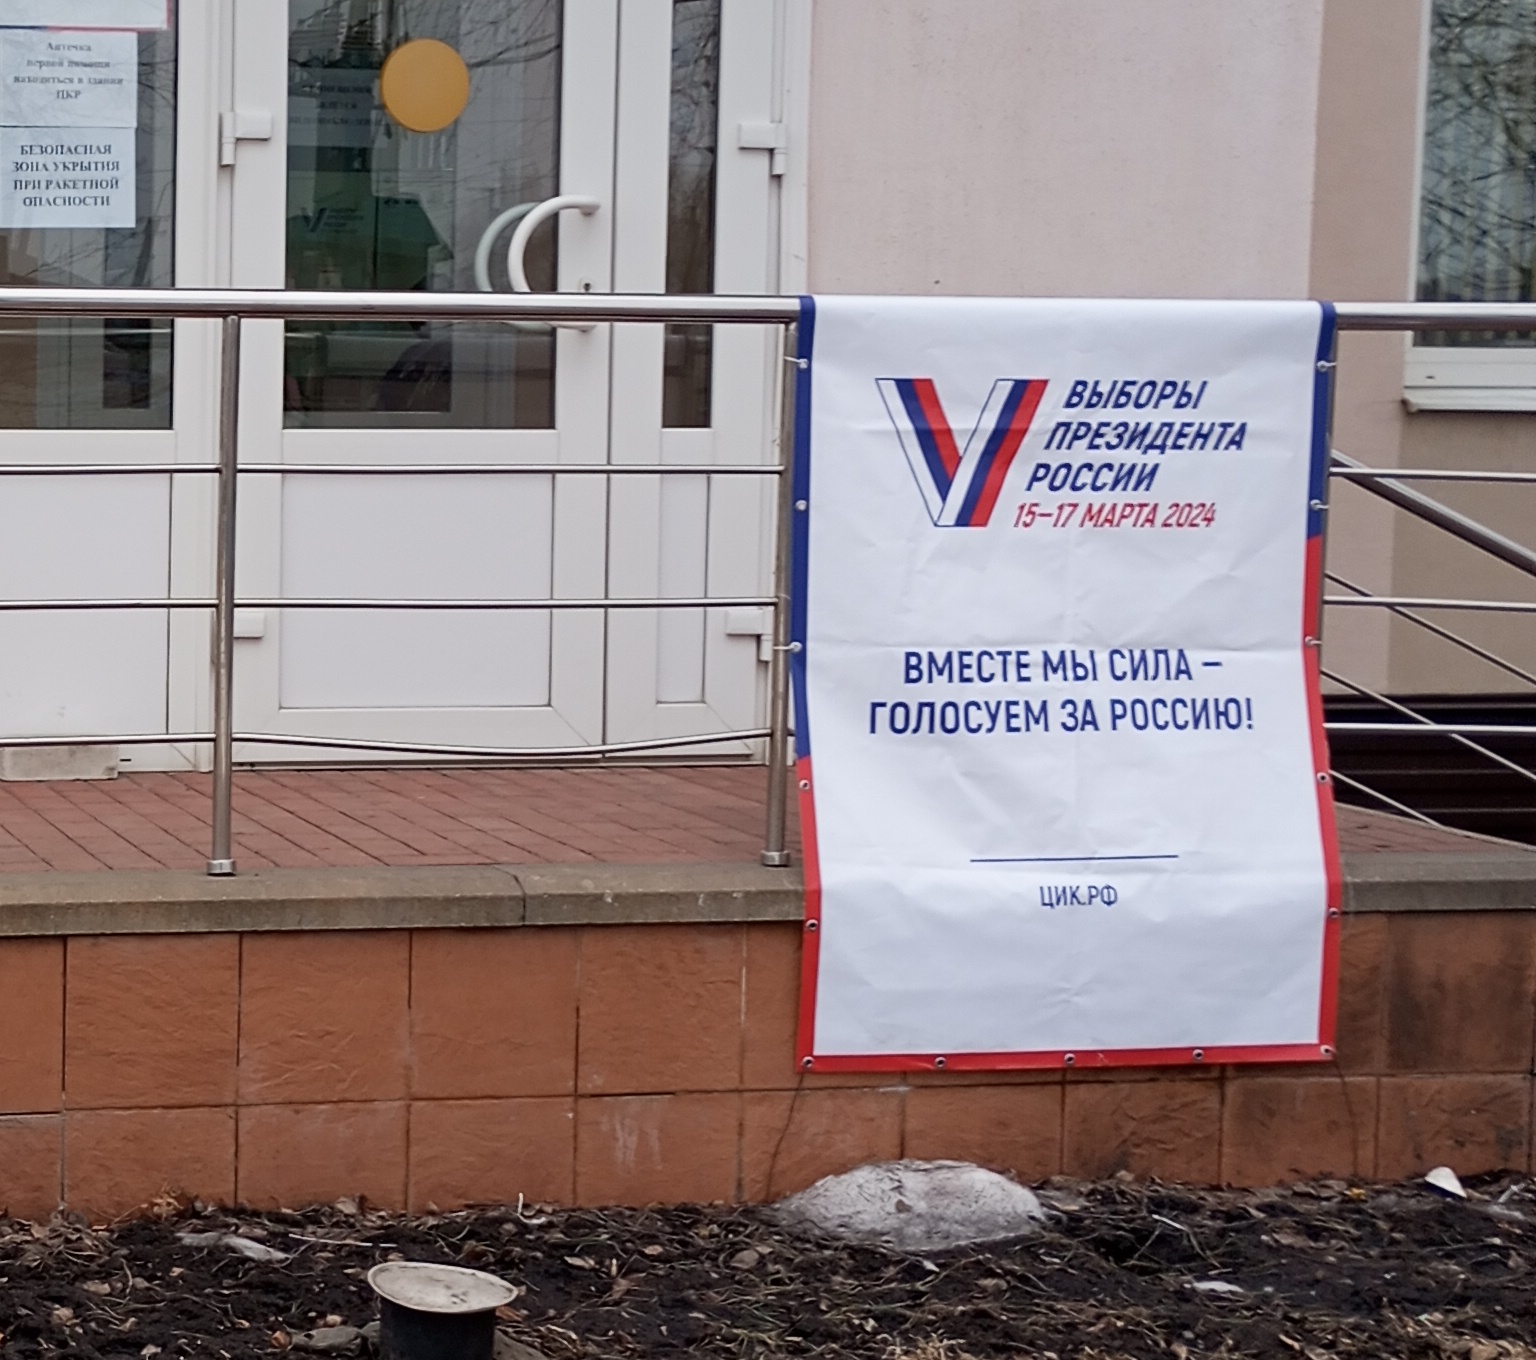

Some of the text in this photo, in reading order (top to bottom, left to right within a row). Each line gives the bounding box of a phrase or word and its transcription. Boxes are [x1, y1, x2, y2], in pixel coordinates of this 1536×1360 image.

[20, 145, 112, 156] БЕЗОПАСНАЯ
[13, 161, 120, 172] ЗОНА УКРЫТИЯ
[14, 178, 119, 190] ПРИ РАКЕТНОЙ
[23, 196, 110, 207] ОПАСНОСТИ
[1063, 380, 1207, 409] ВЫБОРЫ
[1044, 422, 1248, 454] ПРЕЗИДЕНТА
[1026, 463, 1160, 492] РОССИИ
[1080, 503, 1158, 528] МАРТА
[1161, 503, 1216, 528] 2024
[904, 648, 1192, 684] ВМЕСТЕ МЫ СИЛА
[869, 697, 1254, 734] ГОЛОСУЕМ ЗА РОССИЮ!
[1039, 884, 1118, 908] ЦИК.РФ
